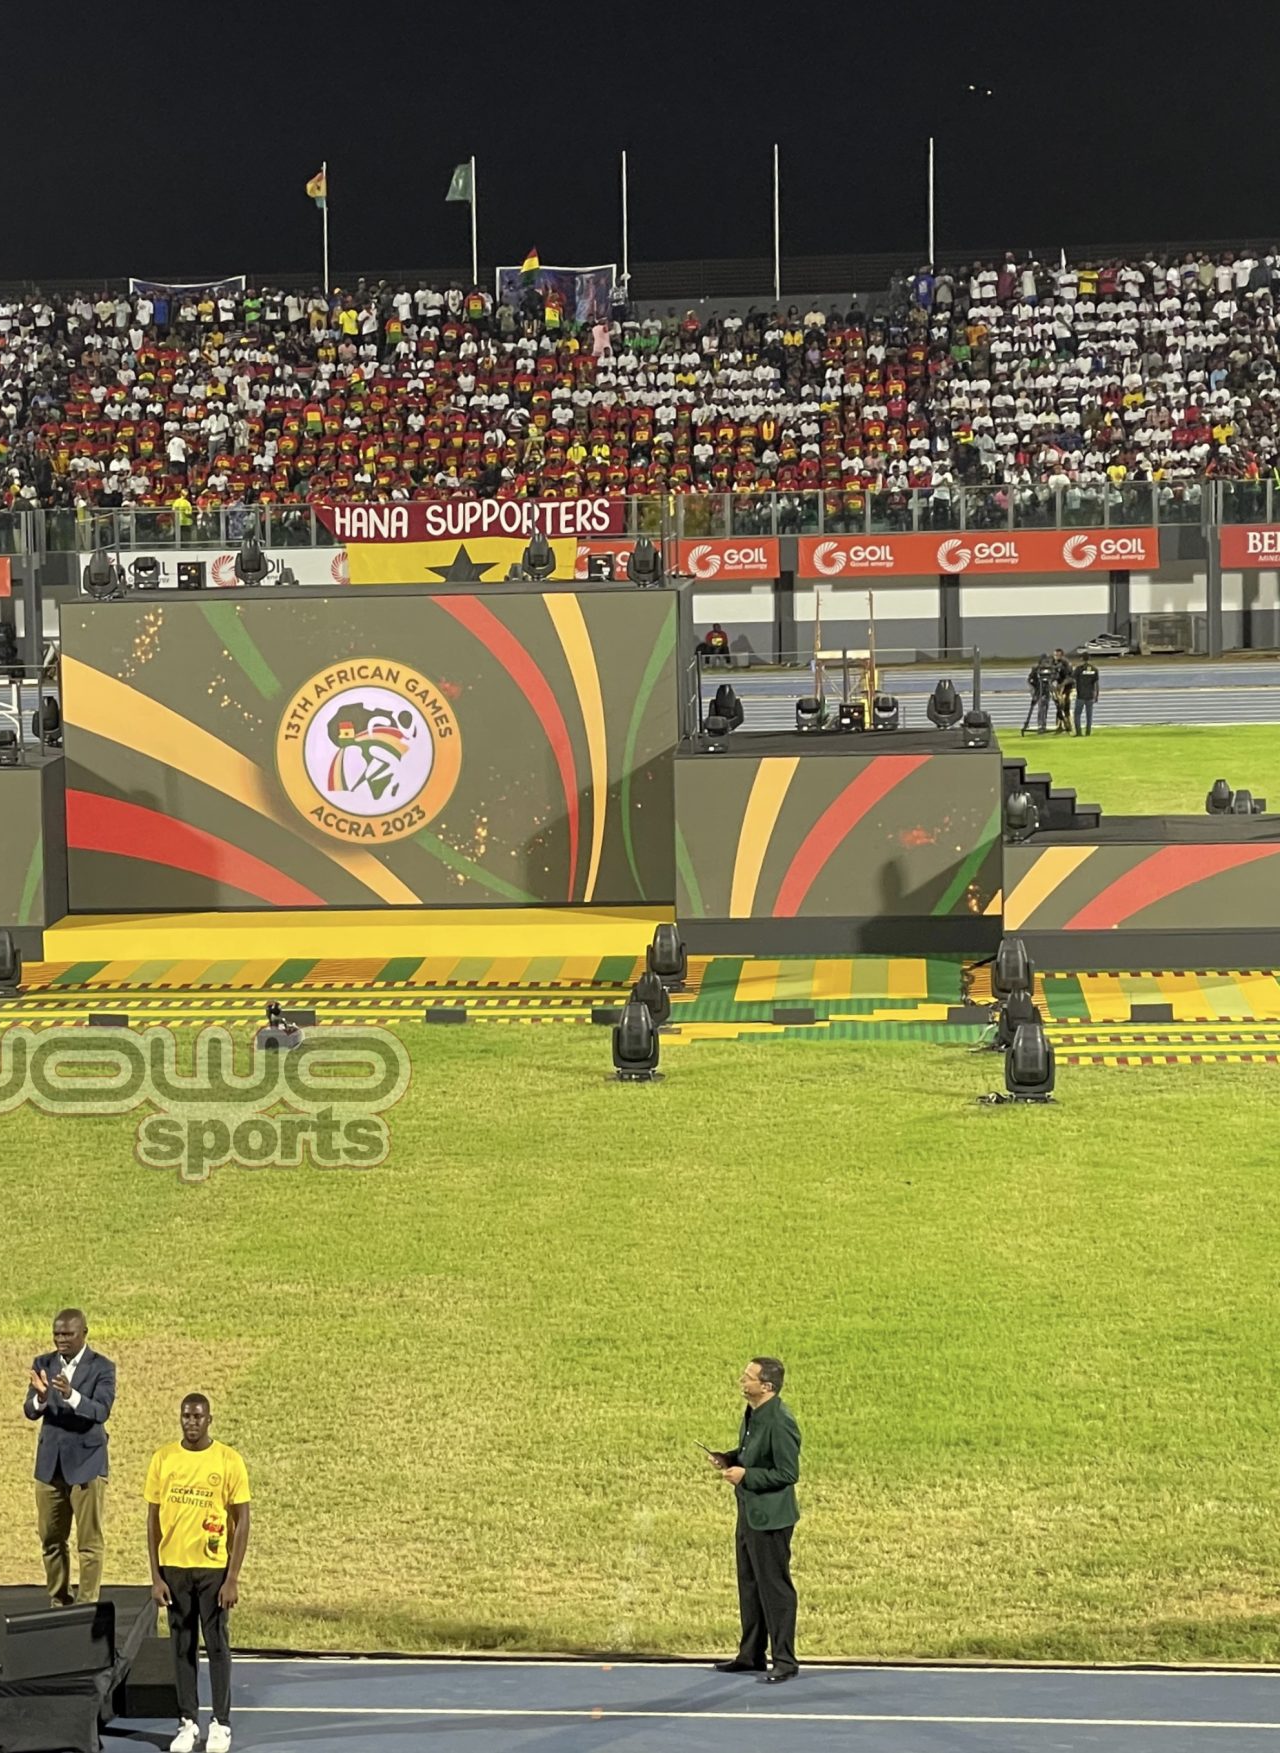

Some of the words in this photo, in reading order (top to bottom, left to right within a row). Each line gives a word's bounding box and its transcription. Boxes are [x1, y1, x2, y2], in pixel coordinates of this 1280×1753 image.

[323, 505, 408, 538] HANA
[426, 499, 610, 535] SUPPORTERS
[974, 542, 1019, 558] GOIL
[1100, 538, 1145, 554] GOIL
[1246, 531, 1280, 554] BE
[724, 547, 767, 563] GOIL
[849, 545, 894, 561] GOIL
[285, 697, 313, 740] 13TH
[314, 665, 400, 698] AFRICAN
[405, 678, 453, 739] GAMES
[310, 805, 376, 837] ACCRA
[381, 804, 426, 836] 2023
